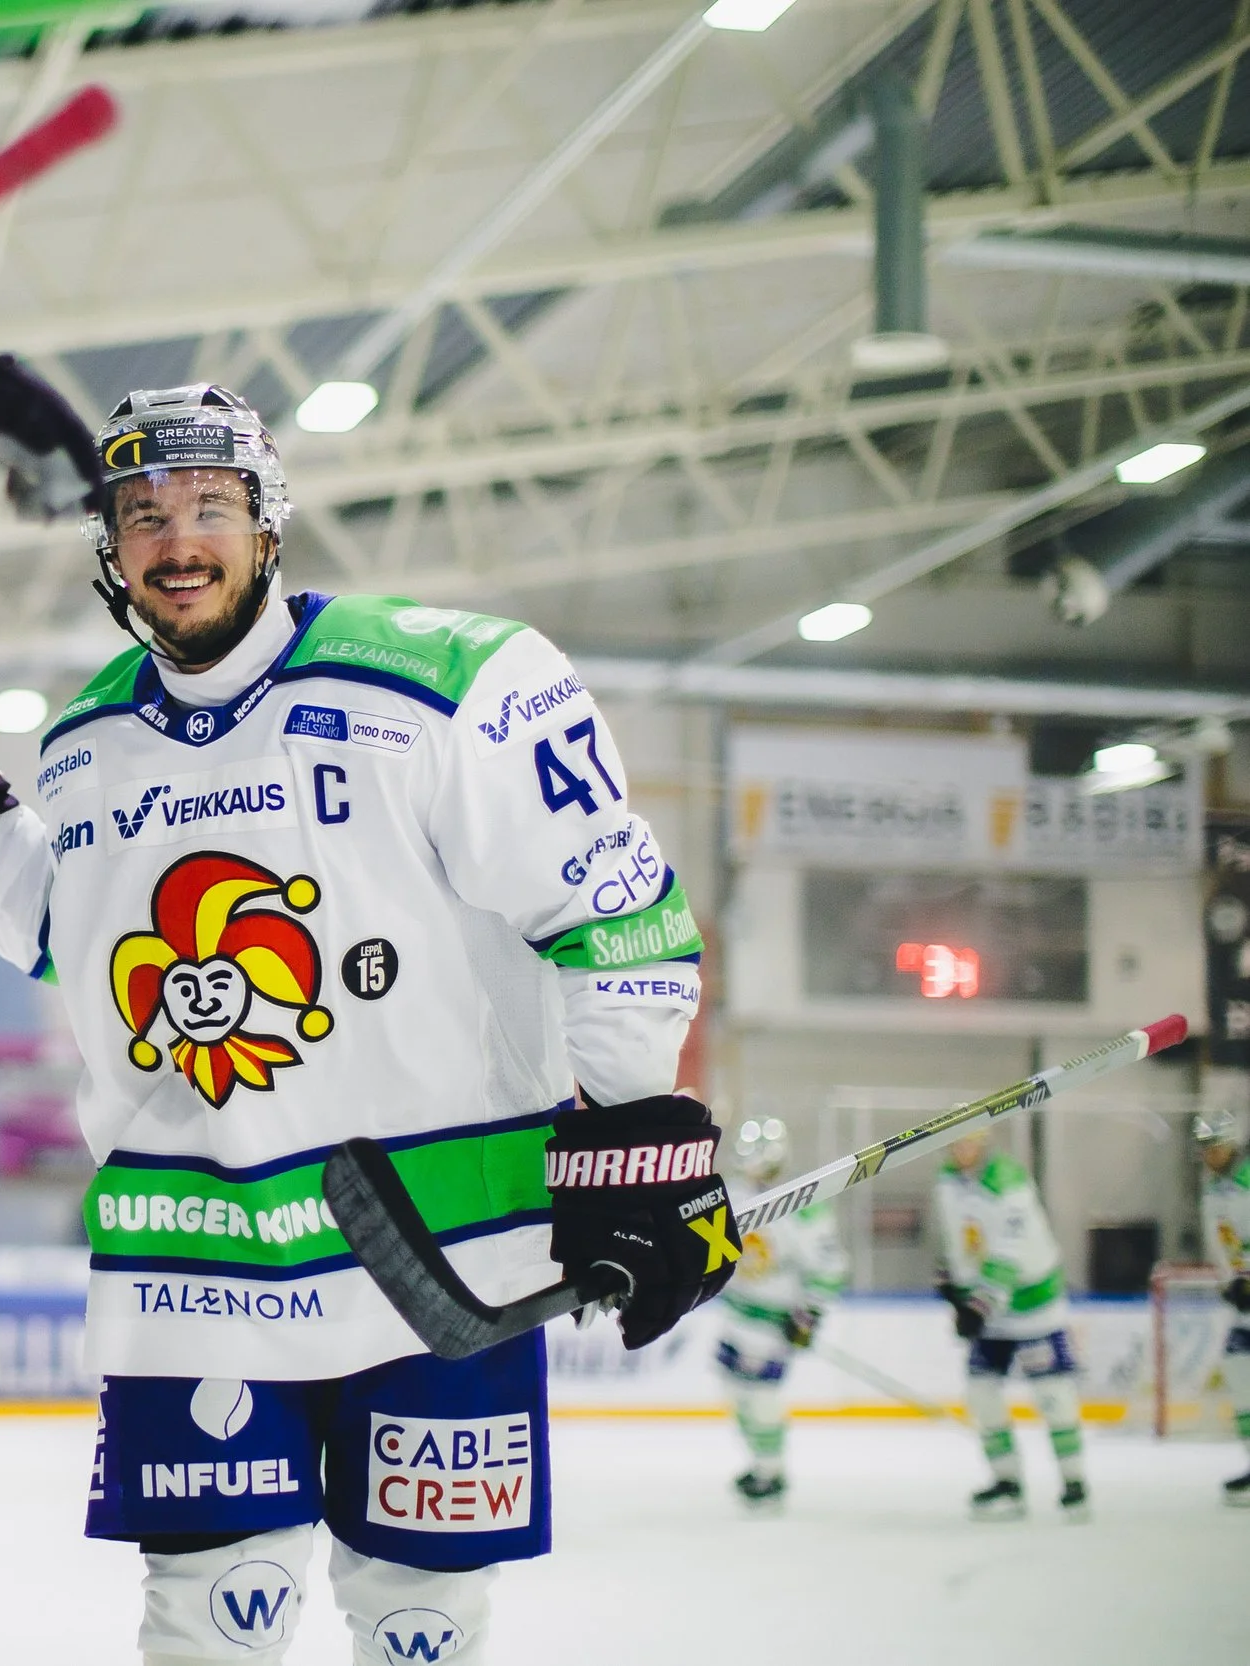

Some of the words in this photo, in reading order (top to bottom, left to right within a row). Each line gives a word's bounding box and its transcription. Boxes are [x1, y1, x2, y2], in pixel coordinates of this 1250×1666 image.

[155, 427, 225, 438] CREATIVE
[157, 437, 225, 447] TECHNOLOGY
[180, 451, 194, 460] Live
[195, 451, 218, 460] Events
[315, 641, 439, 683] ALEXANDRIA
[138, 703, 170, 731] KULTA
[232, 678, 273, 722] HOPEA
[300, 710, 336, 725] TAKSI
[291, 720, 340, 738] HELSINKI
[352, 723, 379, 738] 0100
[381, 729, 410, 745] 0700
[534, 716, 623, 817] 47
[161, 783, 286, 827] VEIKKAUS
[313, 763, 350, 825] C
[592, 840, 659, 915] CHS
[591, 916, 663, 966] Saldo
[661, 906, 699, 950] Ban
[356, 956, 385, 992] 15
[545, 1139, 714, 1188] WARRIOR
[97, 1193, 254, 1239] BURGER
[678, 1186, 727, 1221] DIMEX
[612, 1229, 654, 1248] ALPHA
[133, 1282, 324, 1320] TALENOM
[374, 1423, 529, 1471] CABLE
[141, 1458, 299, 1498] INFUEL
[378, 1475, 524, 1521] CREW
[221, 1586, 290, 1632] W
